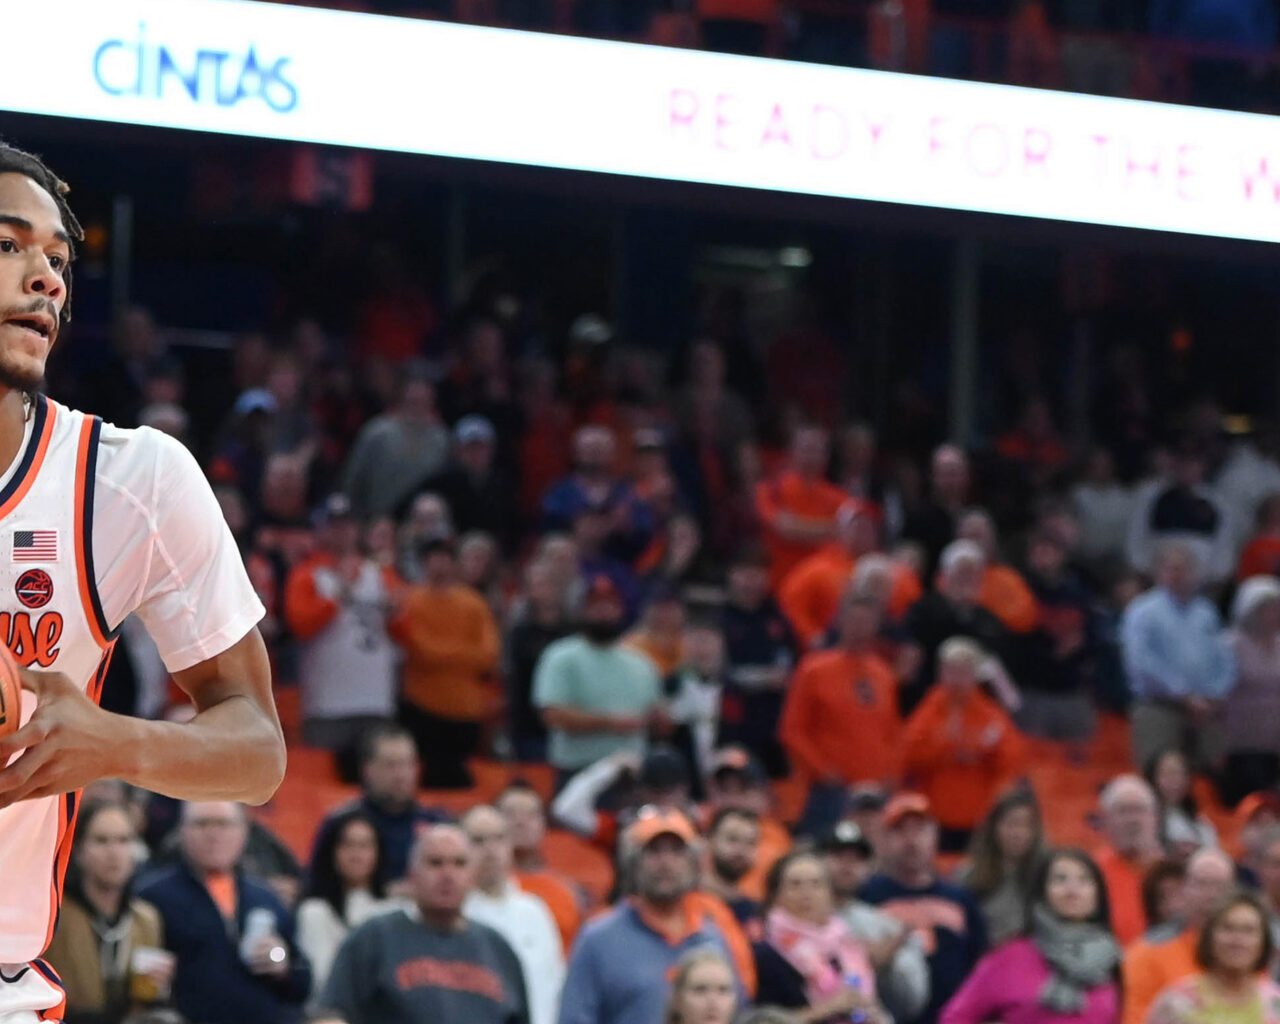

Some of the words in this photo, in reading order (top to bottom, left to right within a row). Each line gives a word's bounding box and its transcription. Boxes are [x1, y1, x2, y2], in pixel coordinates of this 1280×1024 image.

[666, 87, 894, 162] READY
[927, 112, 1054, 179] FOR
[1087, 131, 1204, 202] THE
